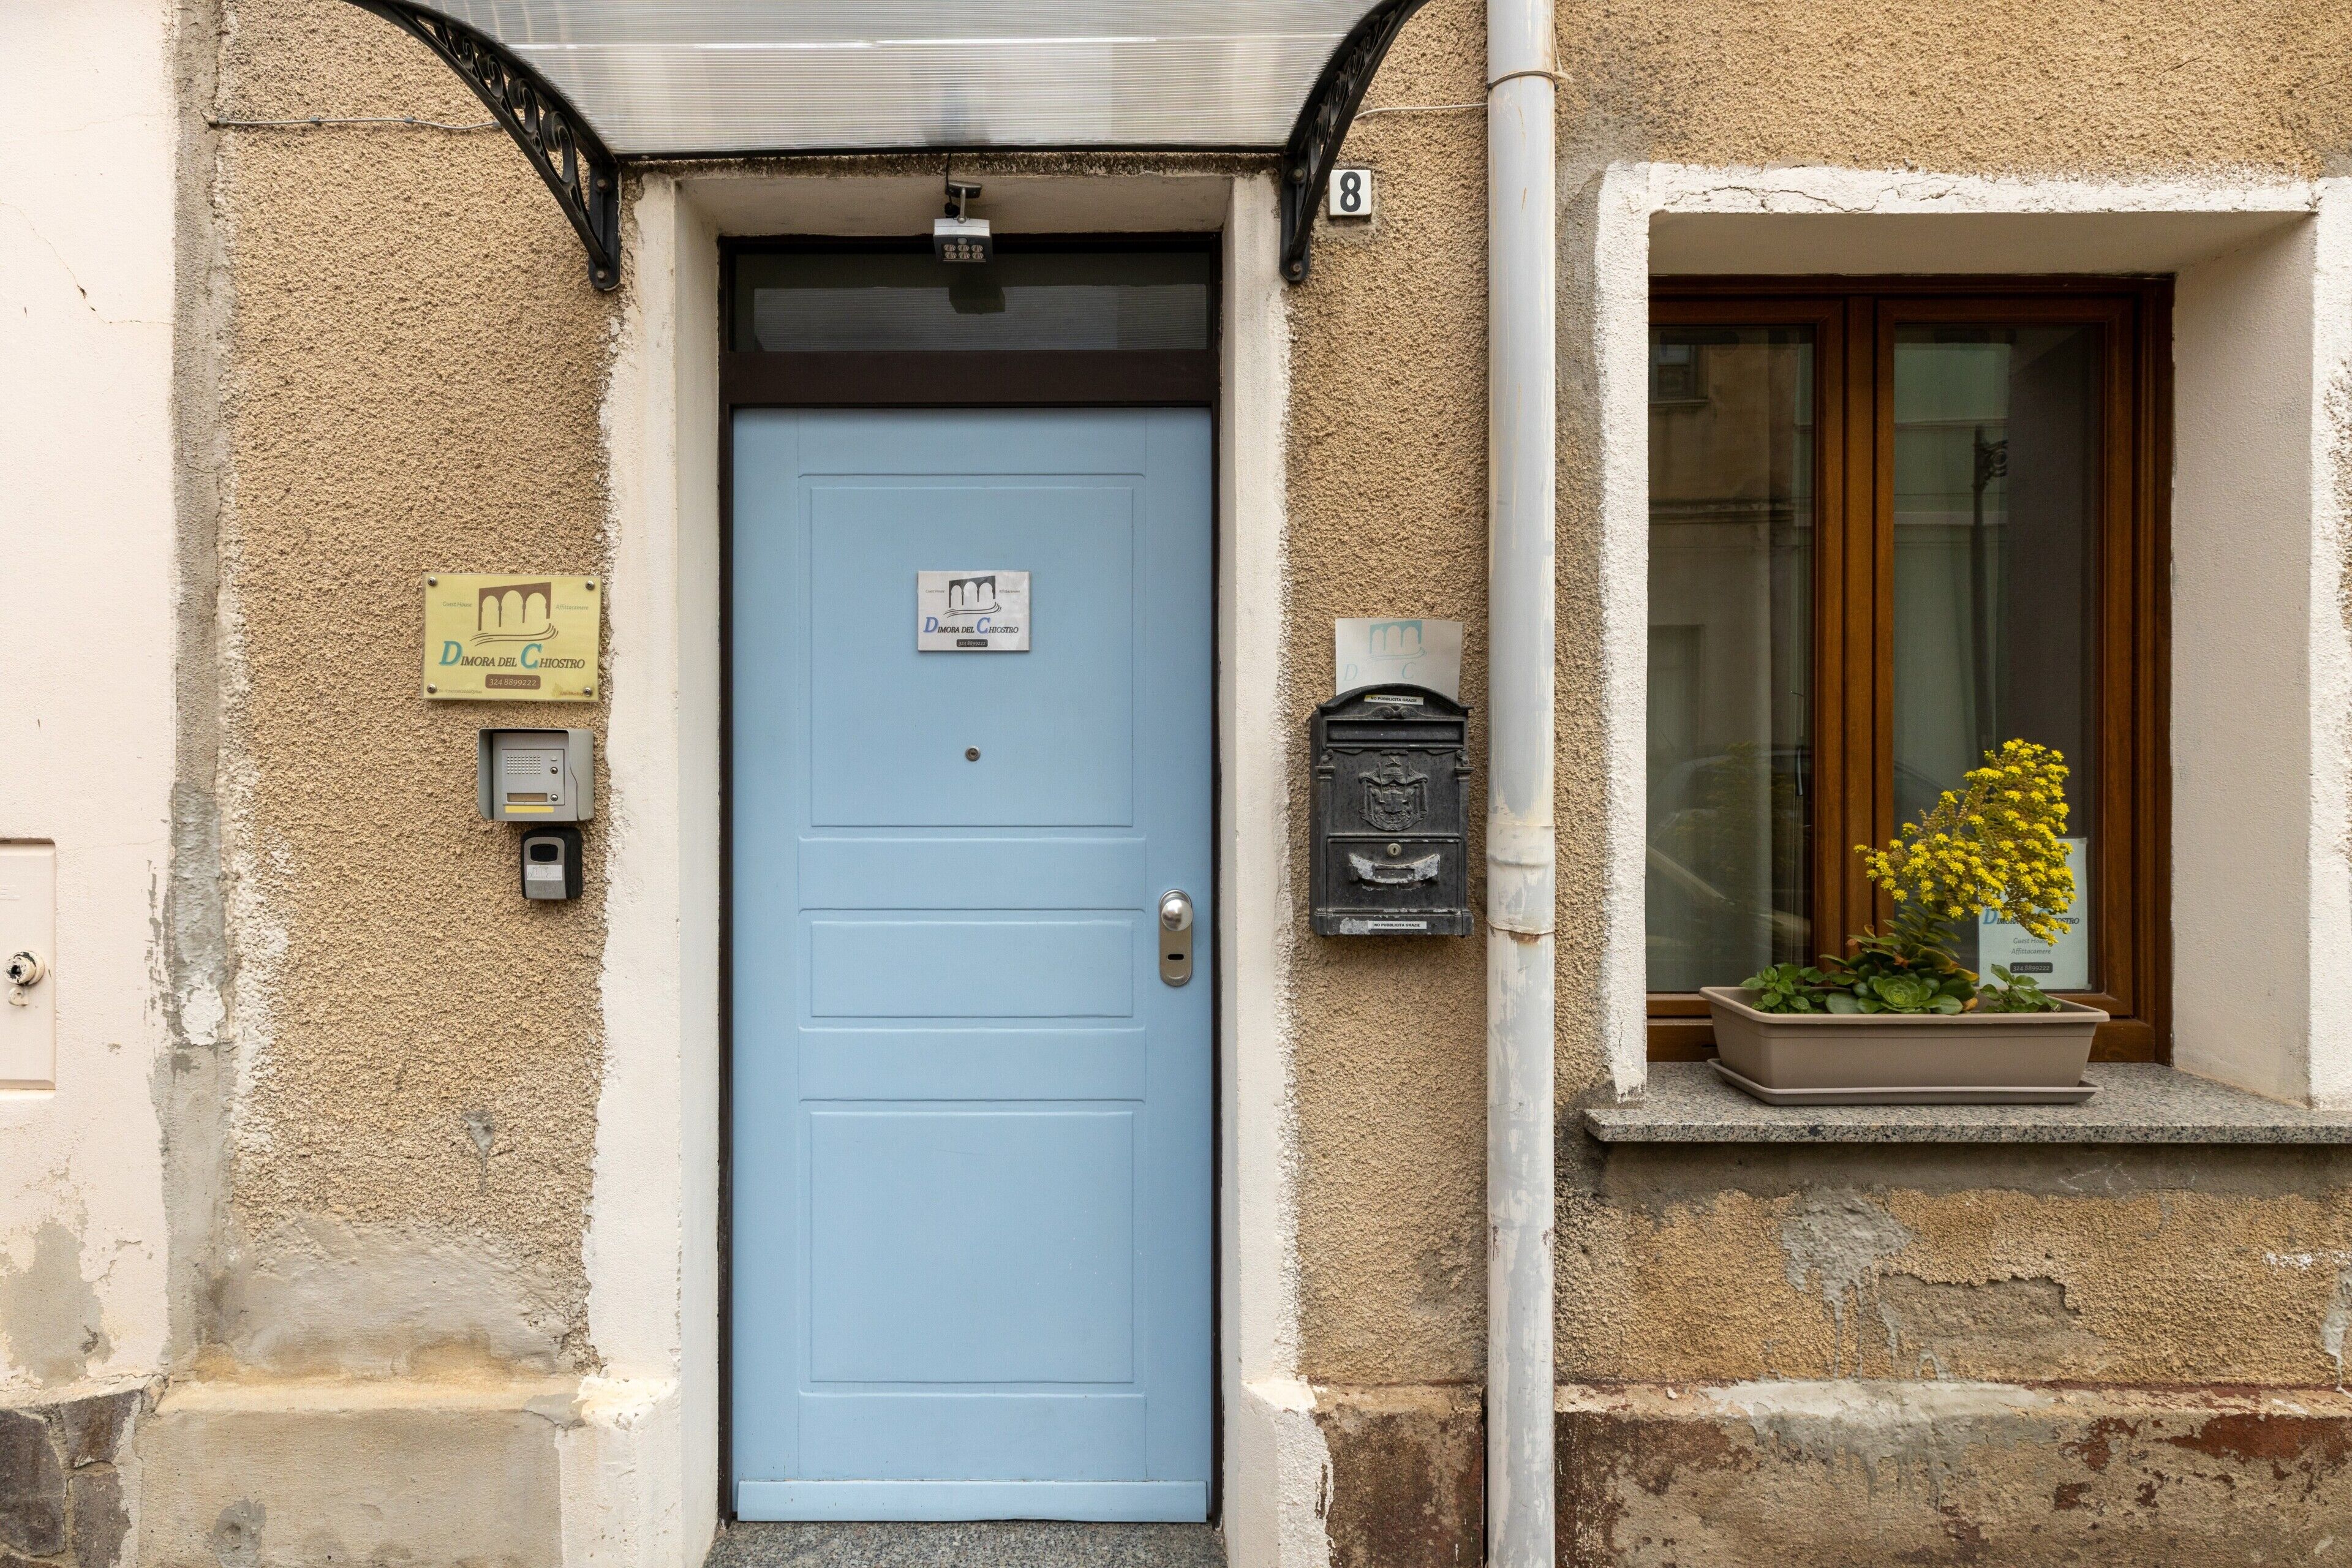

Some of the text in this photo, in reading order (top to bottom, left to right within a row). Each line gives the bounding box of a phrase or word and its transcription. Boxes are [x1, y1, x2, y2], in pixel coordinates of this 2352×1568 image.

[1340, 172, 1361, 212] 8
[923, 617, 960, 633] DIMORA
[976, 617, 1019, 634] CHIOSTRO
[439, 641, 585, 669] DIMORA DEL CHIOSTRO
[504, 678, 537, 687] 8899222
